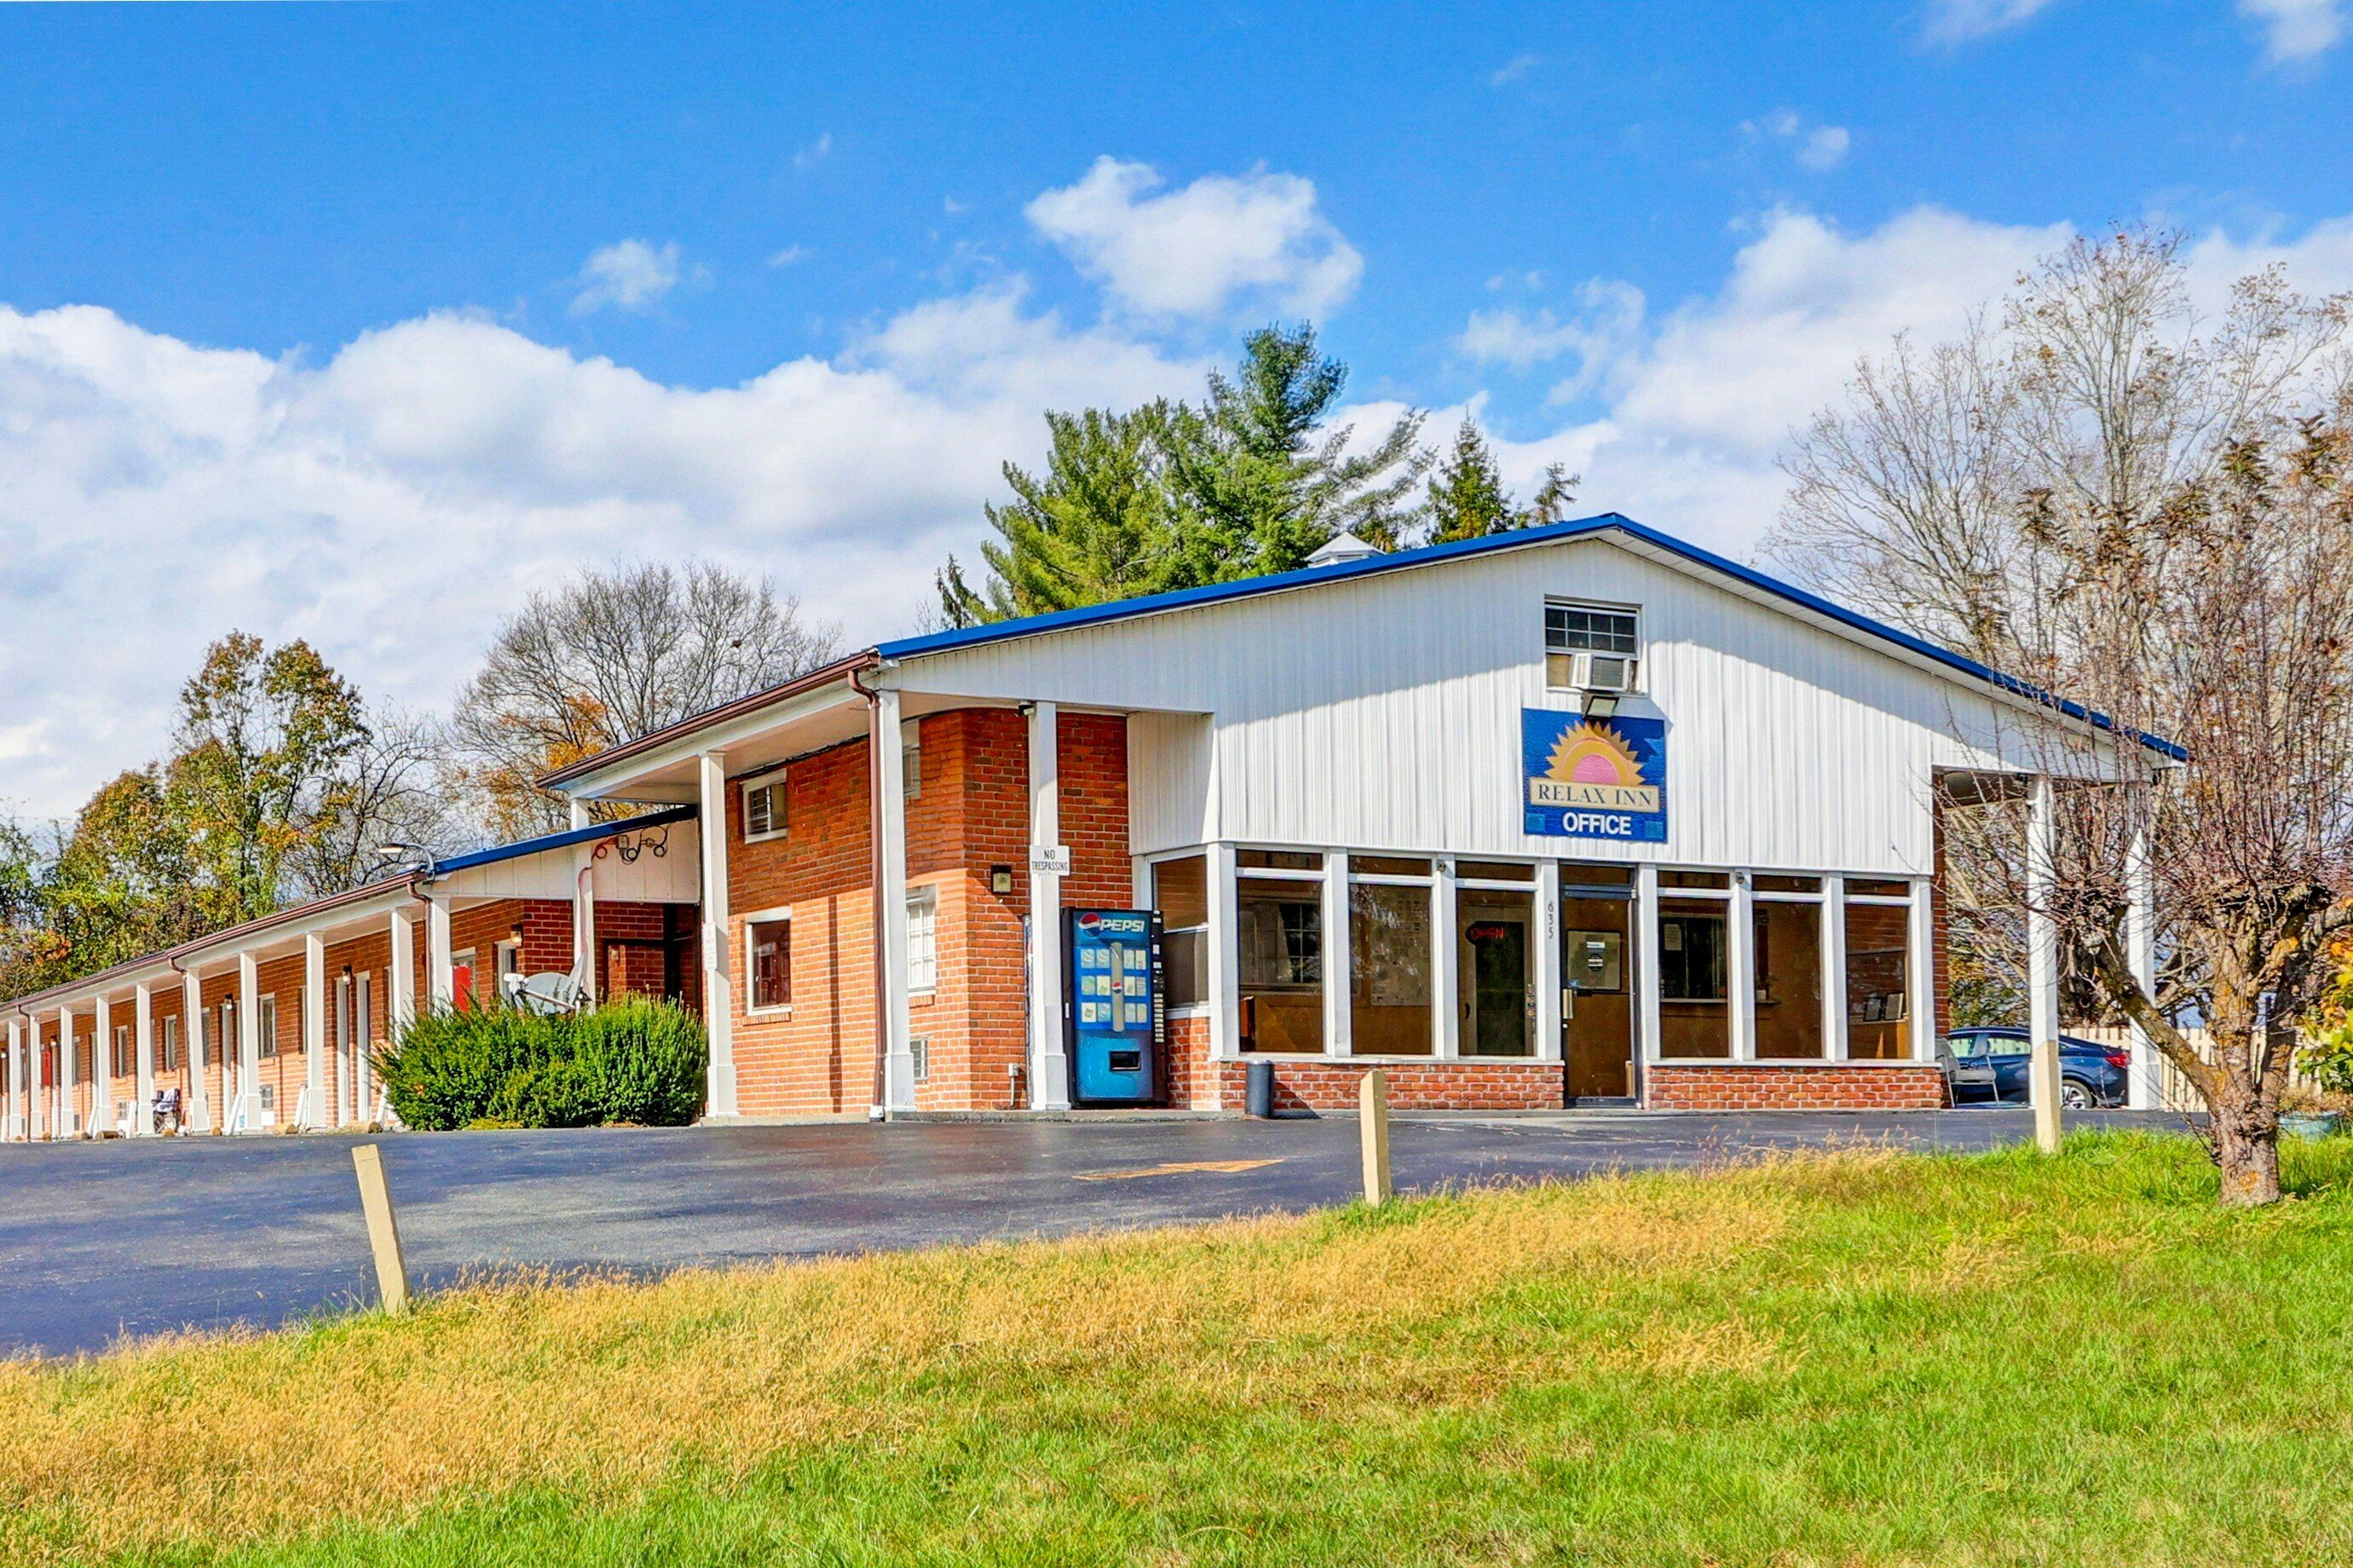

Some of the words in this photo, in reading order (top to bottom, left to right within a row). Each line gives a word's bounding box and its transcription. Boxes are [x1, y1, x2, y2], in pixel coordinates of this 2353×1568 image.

[1538, 783, 1606, 804] RELAX
[1615, 788, 1652, 806] INN
[1562, 811, 1632, 835] OFFICE
[1043, 849, 1056, 860] NO
[1031, 861, 1069, 871] TRESPASSING
[1099, 919, 1145, 933] PEPSI
[1470, 926, 1506, 940] OPEN
